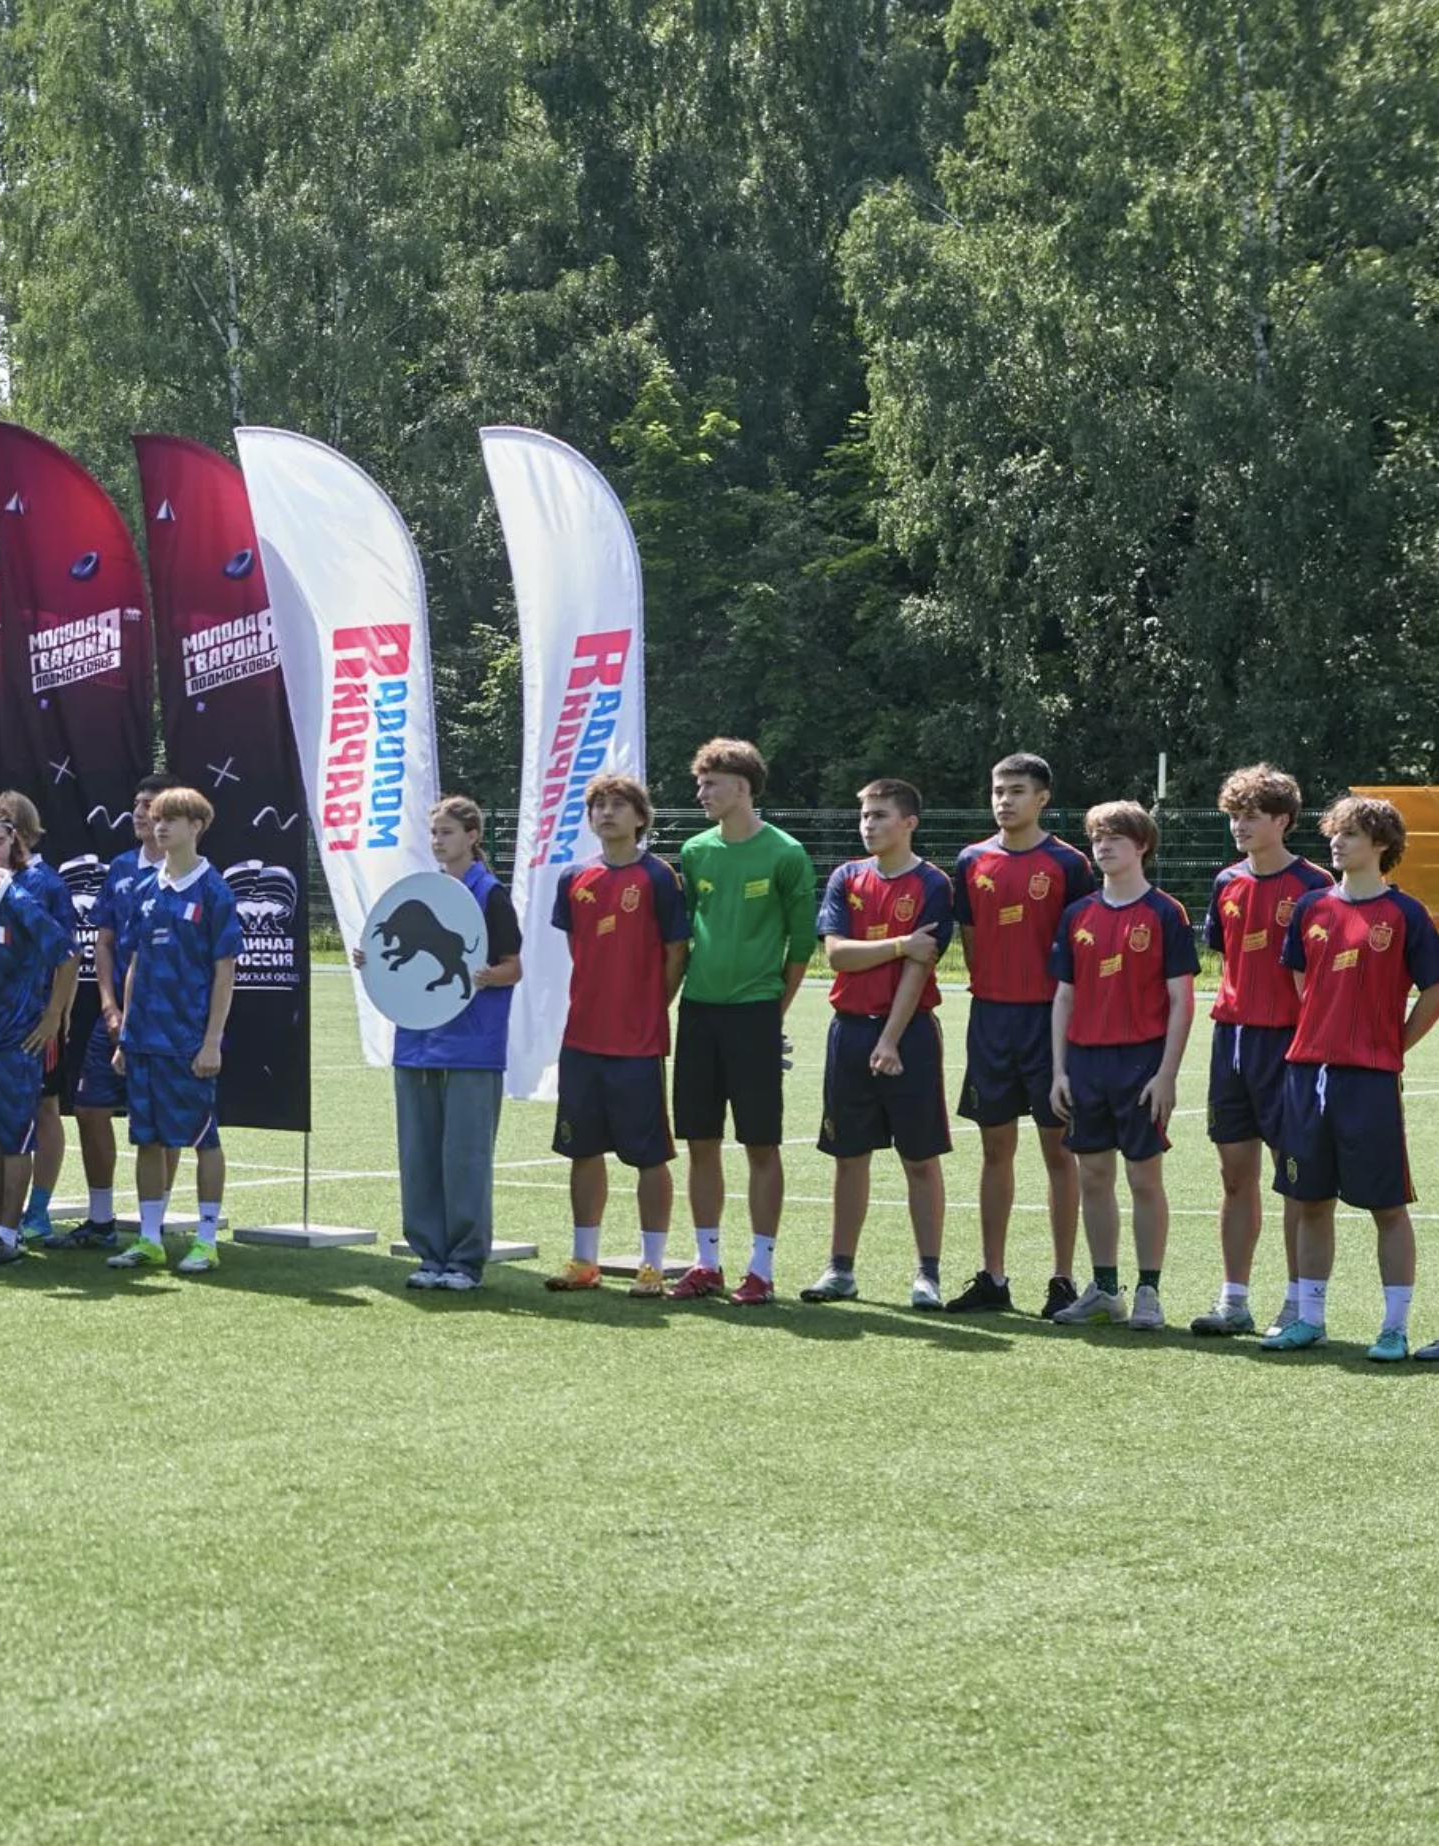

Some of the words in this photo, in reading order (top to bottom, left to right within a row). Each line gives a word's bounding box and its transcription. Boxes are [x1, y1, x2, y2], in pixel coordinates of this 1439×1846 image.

[29, 607, 121, 652] МОЛОДАЯ
[242, 938, 294, 951] ИНАЯ
[235, 953, 294, 967] ОССИЯ
